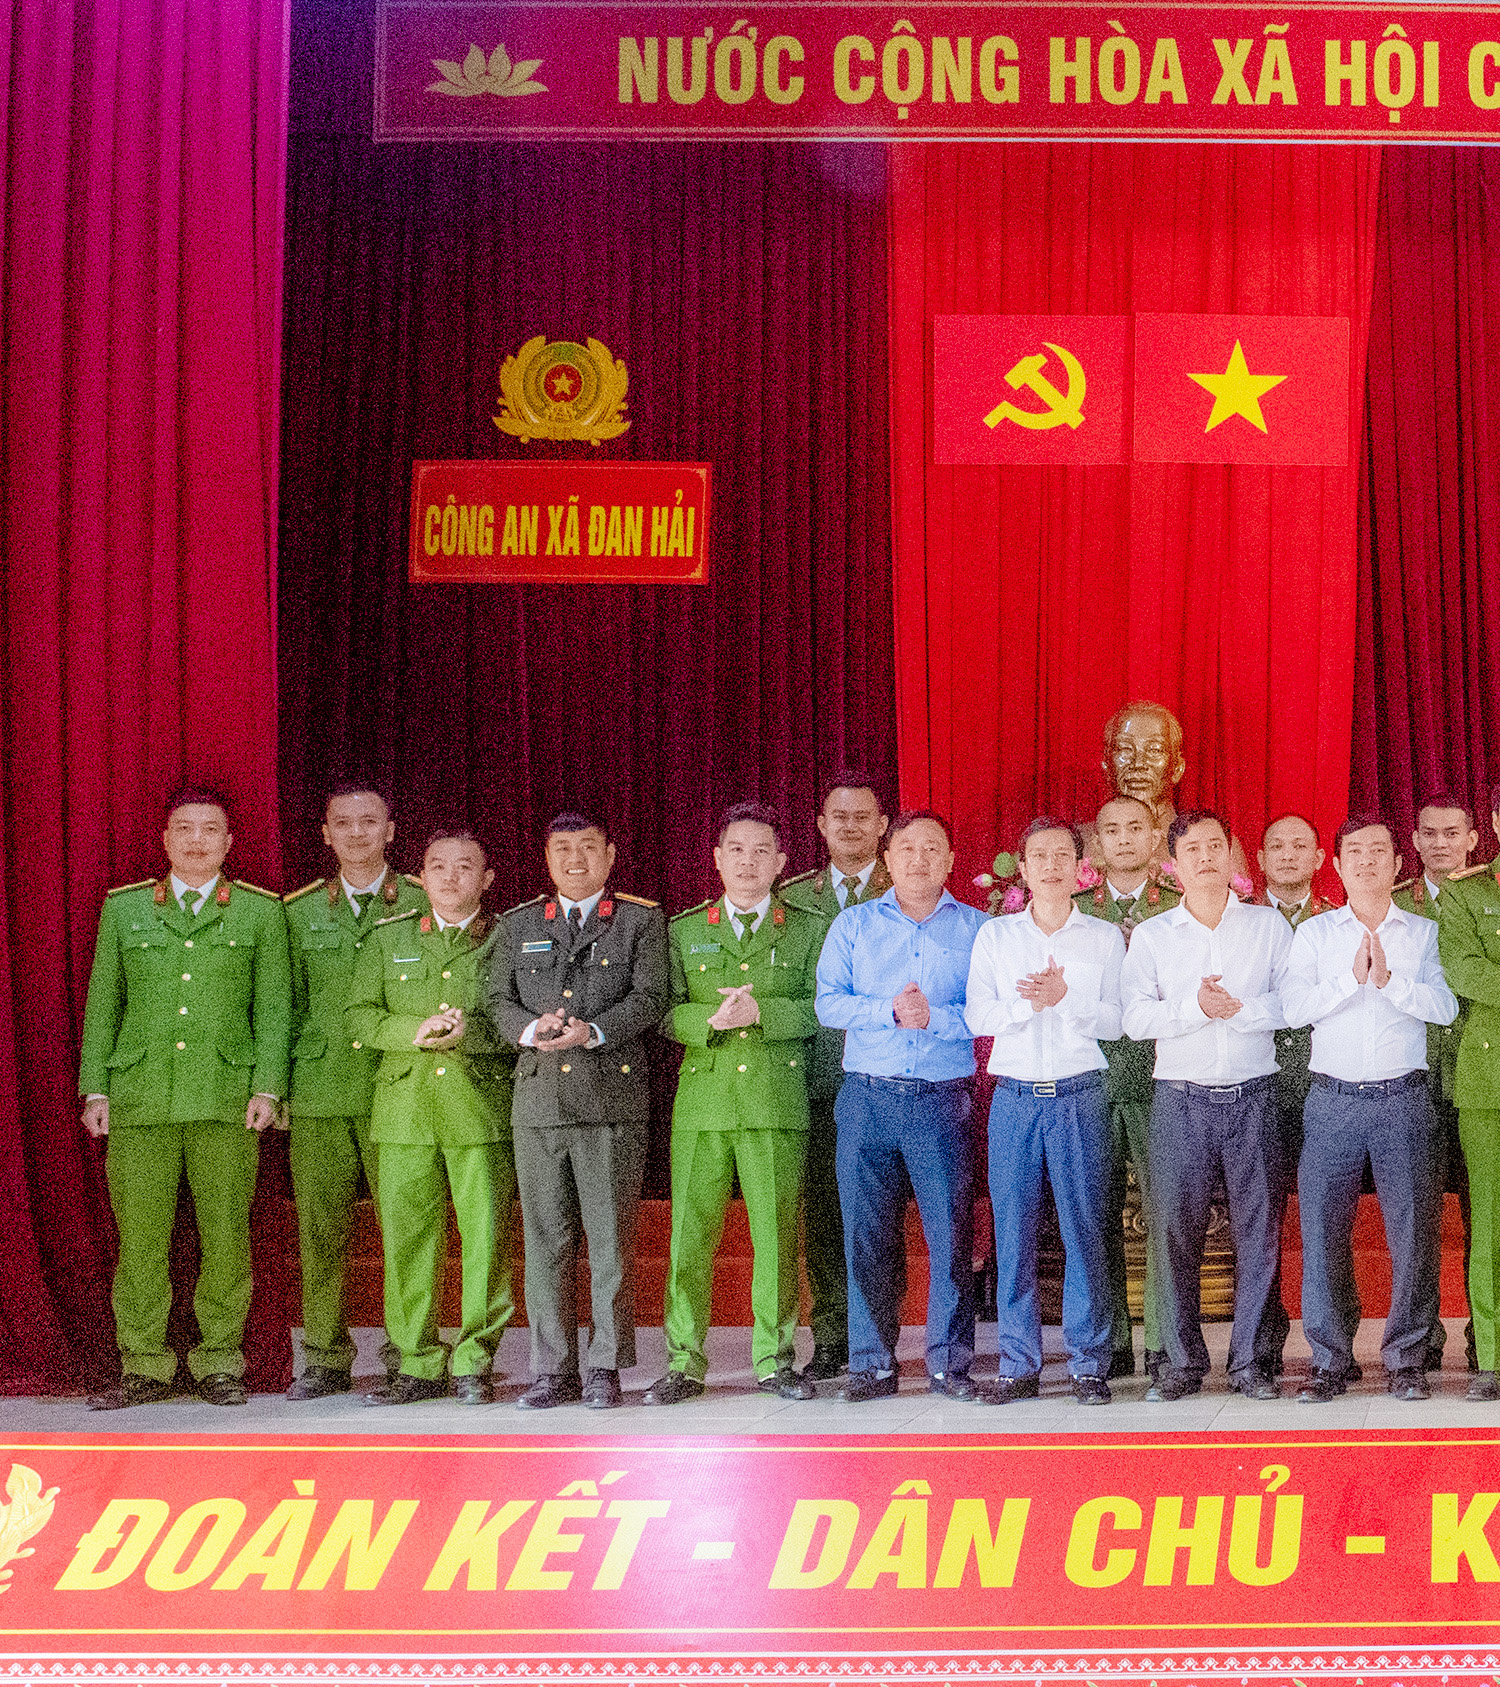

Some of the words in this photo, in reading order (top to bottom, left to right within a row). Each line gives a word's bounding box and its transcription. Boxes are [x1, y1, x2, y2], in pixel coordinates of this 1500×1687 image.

[618, 20, 804, 104] NƯỚC
[833, 19, 1020, 119] CỘNG
[1049, 20, 1188, 105] HÒA
[1212, 23, 1298, 106] XÃ
[1324, 23, 1440, 124] HỘI
[424, 494, 494, 556] CÔNG
[501, 505, 539, 556] AN
[545, 495, 580, 556] XÃ
[588, 505, 643, 556] ĐAN
[650, 489, 695, 557] HẢI
[54, 1478, 420, 1592] ĐOÀN
[422, 1470, 668, 1592] KẾT
[768, 1480, 1031, 1590] DÂN
[1064, 1464, 1304, 1588] CHỦ
